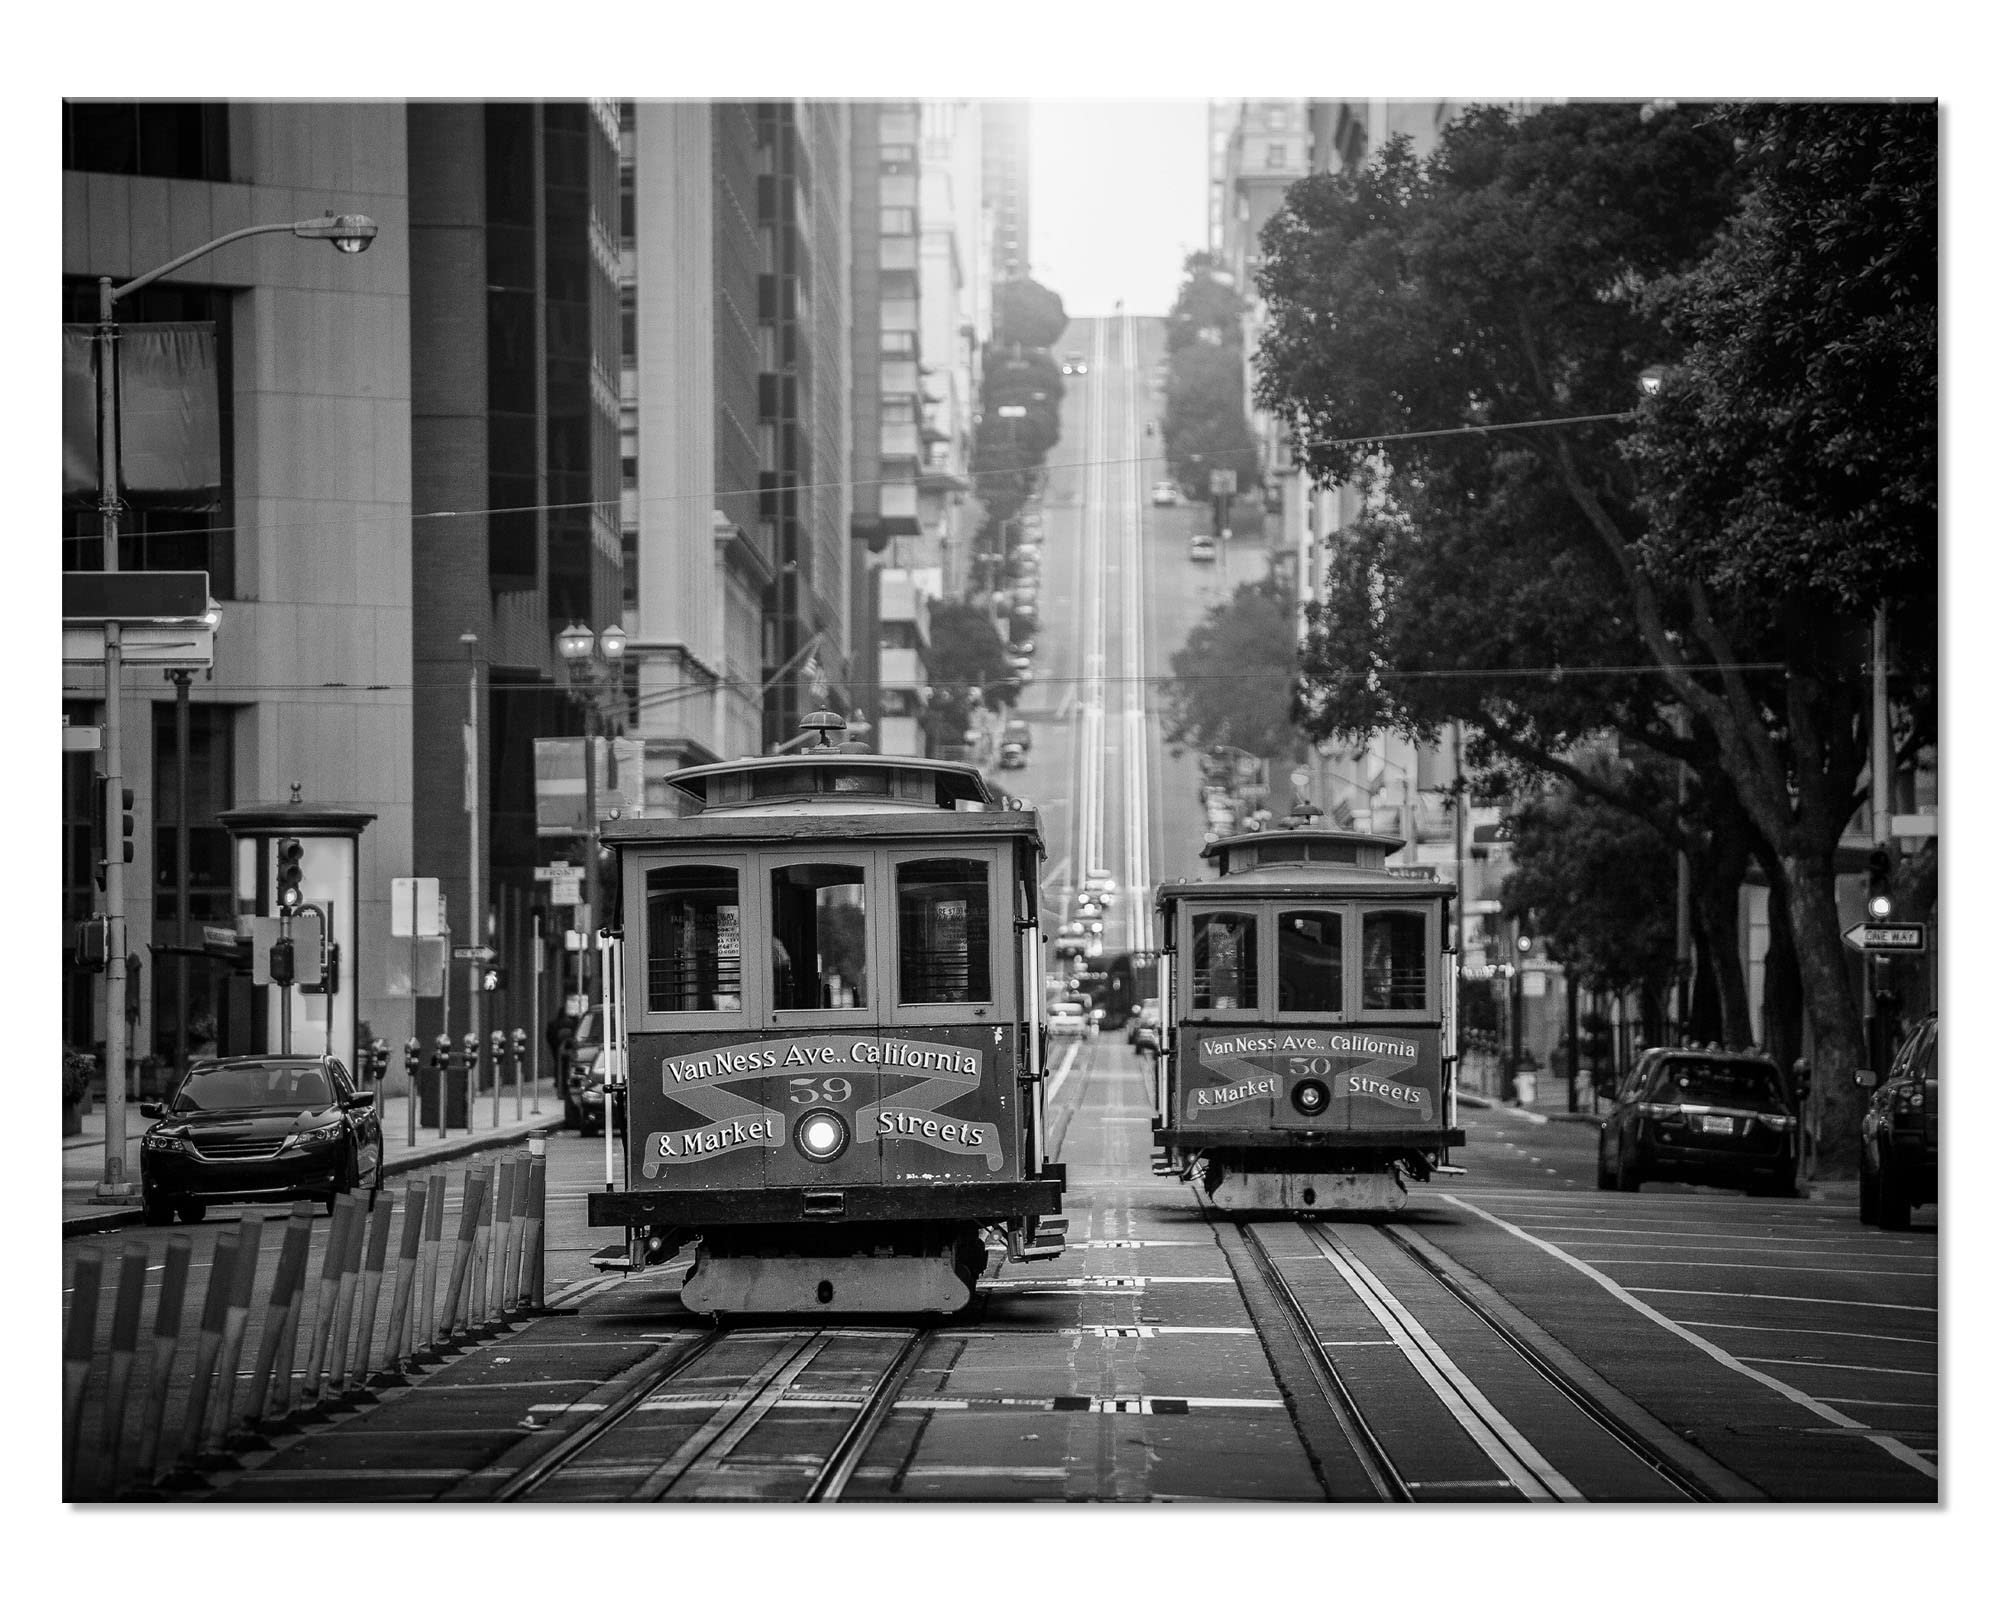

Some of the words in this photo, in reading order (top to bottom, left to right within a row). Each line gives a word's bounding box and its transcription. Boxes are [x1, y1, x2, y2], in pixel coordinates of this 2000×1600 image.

[1865, 930, 1889, 941] ONE
[1892, 930, 1915, 942] WAY
[1204, 1041, 1234, 1056] Van
[1235, 1037, 1277, 1052] Ness
[1330, 1035, 1415, 1057] California
[669, 1060, 712, 1083] Van
[714, 1050, 776, 1076] Ness
[850, 1041, 977, 1075] California
[1289, 1057, 1331, 1075] 50
[789, 1077, 852, 1104] 59
[1197, 1090, 1210, 1105] &
[1213, 1079, 1276, 1105] Market
[1349, 1076, 1421, 1103] Streets
[658, 1135, 678, 1156] &
[681, 1118, 773, 1156] Market
[877, 1111, 985, 1147] Streets
